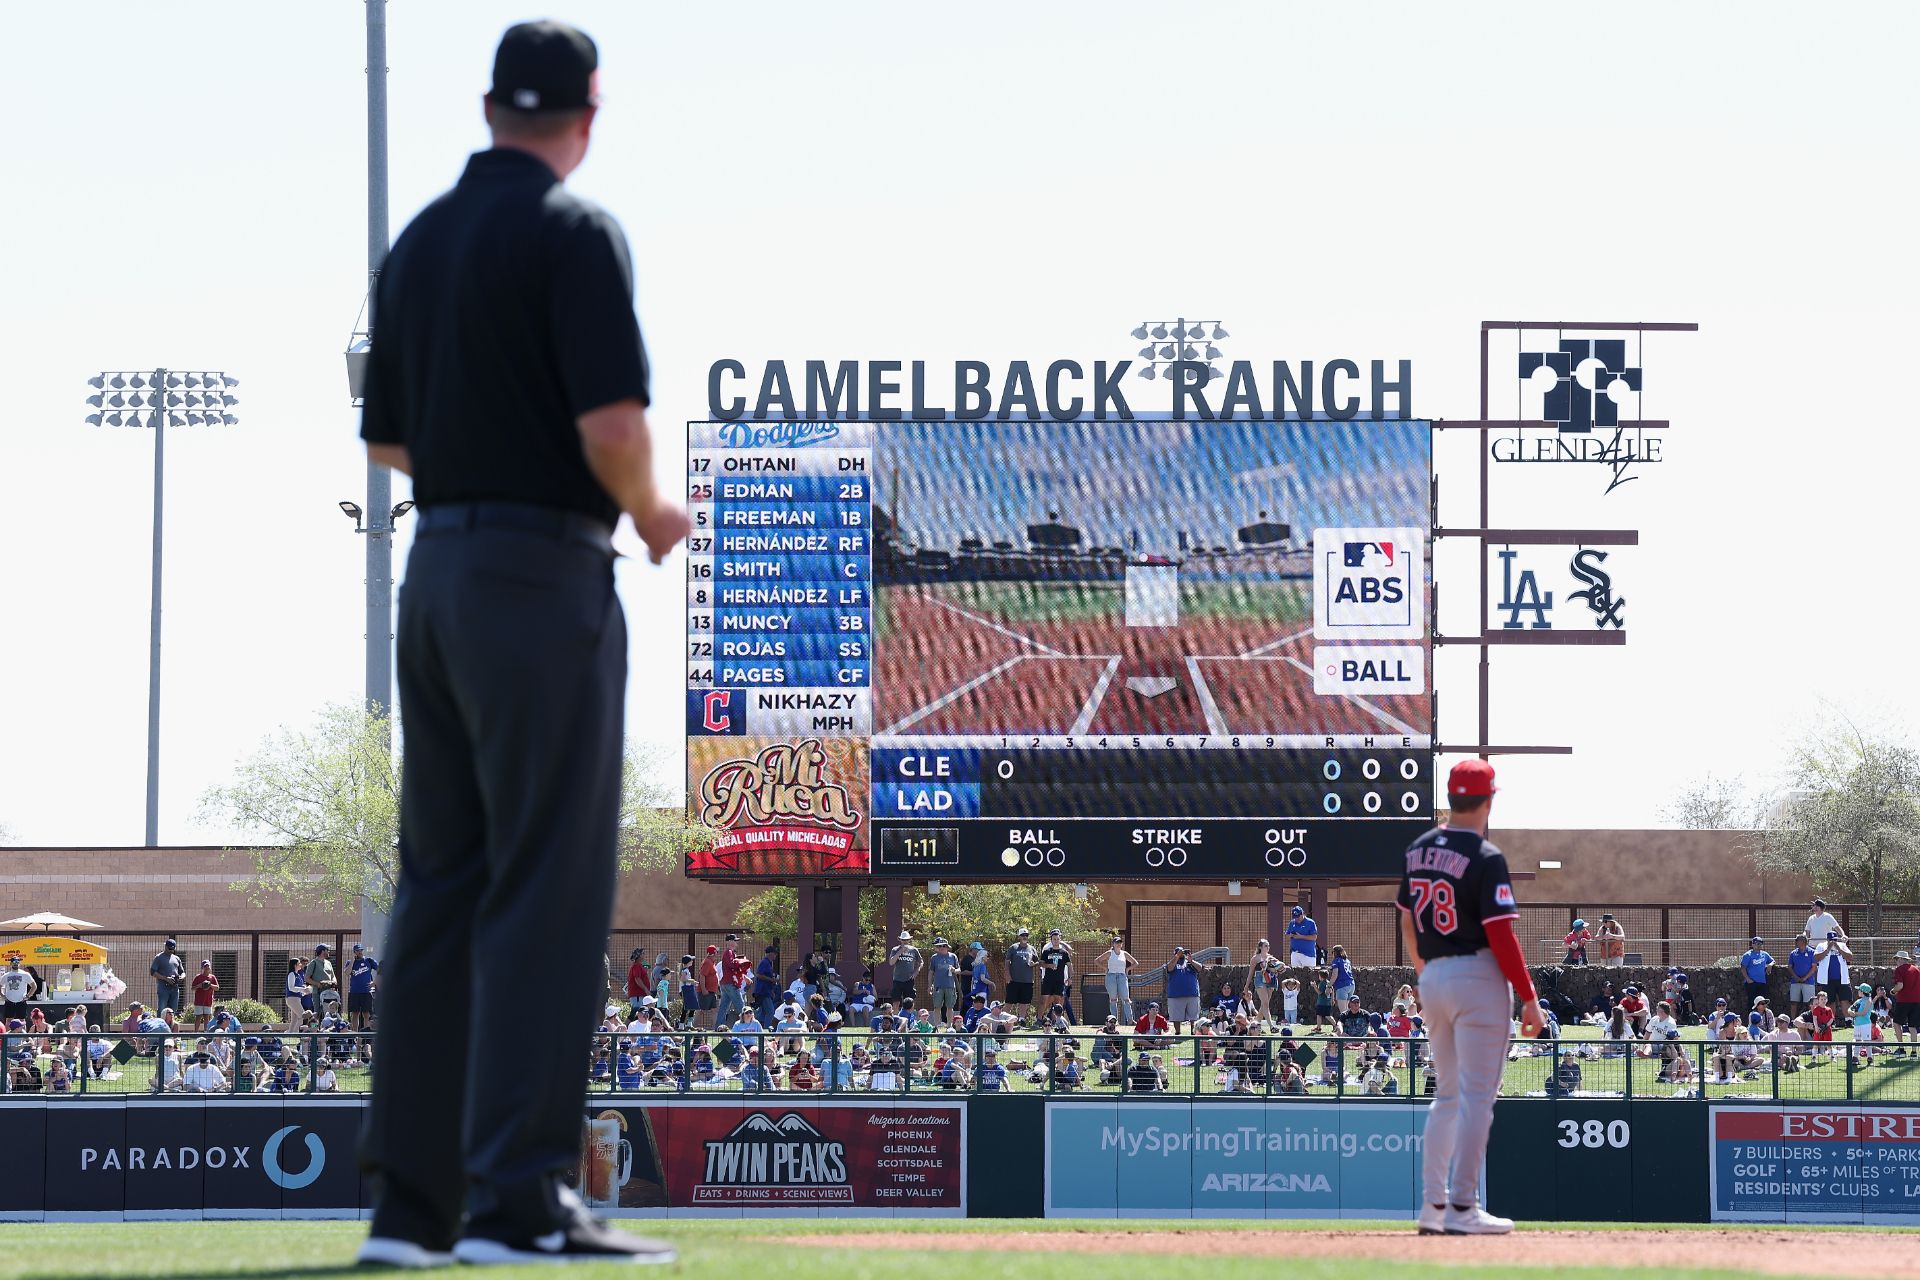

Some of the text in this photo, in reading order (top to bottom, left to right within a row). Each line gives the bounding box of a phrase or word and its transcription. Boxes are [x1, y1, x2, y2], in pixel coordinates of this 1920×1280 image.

[708, 359, 1411, 420] CAMELBACK RANCH
[1491, 432, 1662, 462] GLENDALE
[692, 458, 865, 472] 17 OHTANI DH
[691, 484, 863, 499] 25 EDMAN 2B
[697, 511, 861, 525] 5 FREEMAN 1B
[692, 533, 863, 551] 37 HERNÁNDEZ RF
[692, 562, 858, 577] 16 SMITH C
[696, 586, 862, 604] 8 HERNÁNDEZ LF
[1334, 577, 1404, 604] ABS
[1498, 551, 1552, 629] LA
[692, 615, 863, 630] 13 MUNCY 3B
[691, 642, 862, 657] 72 ROJAS SS
[689, 668, 863, 683] 44 PAGES CF
[1342, 660, 1411, 682] BALL
[758, 694, 857, 709] NIKHAZY
[812, 717, 853, 730] MPH
[1002, 738, 1411, 747] 1 2 3 4 5 6 7 8 9 R H E
[757, 739, 827, 787] Mi
[899, 757, 1419, 780] CLE 0 0 0 0
[898, 791, 1419, 813] LAD 0 0 0
[745, 830, 785, 844] QUALITY
[787, 831, 847, 849] MICHELADAS
[1009, 829, 1060, 844] BALL
[1132, 829, 1202, 844] STRIKE
[1265, 829, 1307, 844] OUT
[904, 839, 937, 857] 1:11
[1409, 878, 1458, 935] 78
[868, 1114, 951, 1128] Arizona Locations
[887, 1131, 933, 1139] PHOENIX
[1101, 1126, 1423, 1157] MySpringTraining.com
[1557, 1119, 1631, 1149] 380
[883, 1145, 937, 1153] GLENDALE
[1733, 1147, 1742, 1159] 7
[1747, 1146, 1822, 1160] BUILDERS
[1846, 1148, 1873, 1161] 50+
[81, 1147, 250, 1170] PARADOX
[705, 1143, 847, 1183] TWIN PEAKS
[877, 1159, 943, 1168] SCOTTSDALE
[891, 1174, 926, 1182] TEMPE
[1733, 1164, 1776, 1176] GOLF
[1801, 1165, 1828, 1178] 65+
[1833, 1166, 1880, 1178] MILES
[1883, 1166, 1897, 1174] OF
[1201, 1173, 1332, 1192] ARIZONA
[1830, 1183, 1880, 1197] CLUBS
[700, 1189, 848, 1198] EATS DRINKS SCENIC VIEWS
[876, 1188, 944, 1197] DEER VALLEY
